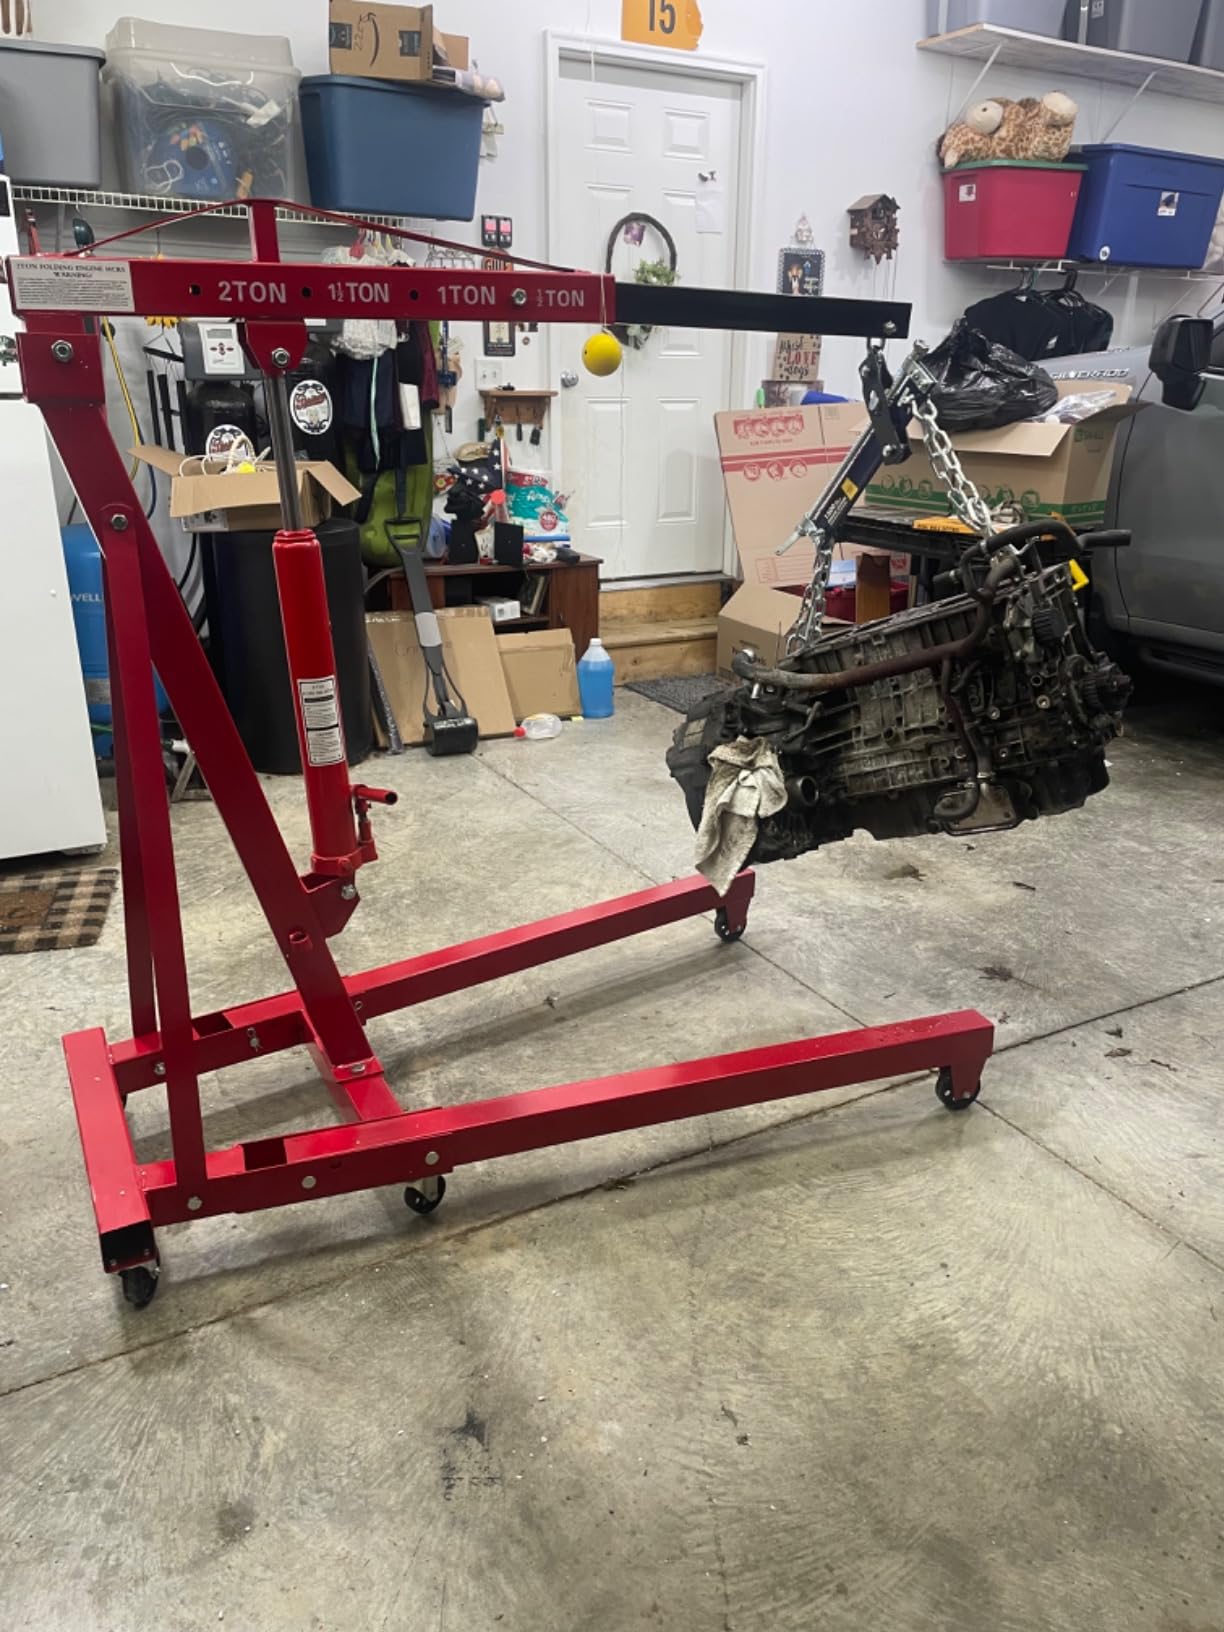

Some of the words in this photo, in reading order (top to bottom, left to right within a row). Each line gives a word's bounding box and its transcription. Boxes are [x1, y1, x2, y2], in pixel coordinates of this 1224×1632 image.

[218, 280, 287, 303] 2TON
[437, 285, 496, 305] 1TON
[786, 351, 817, 365] LOVE
